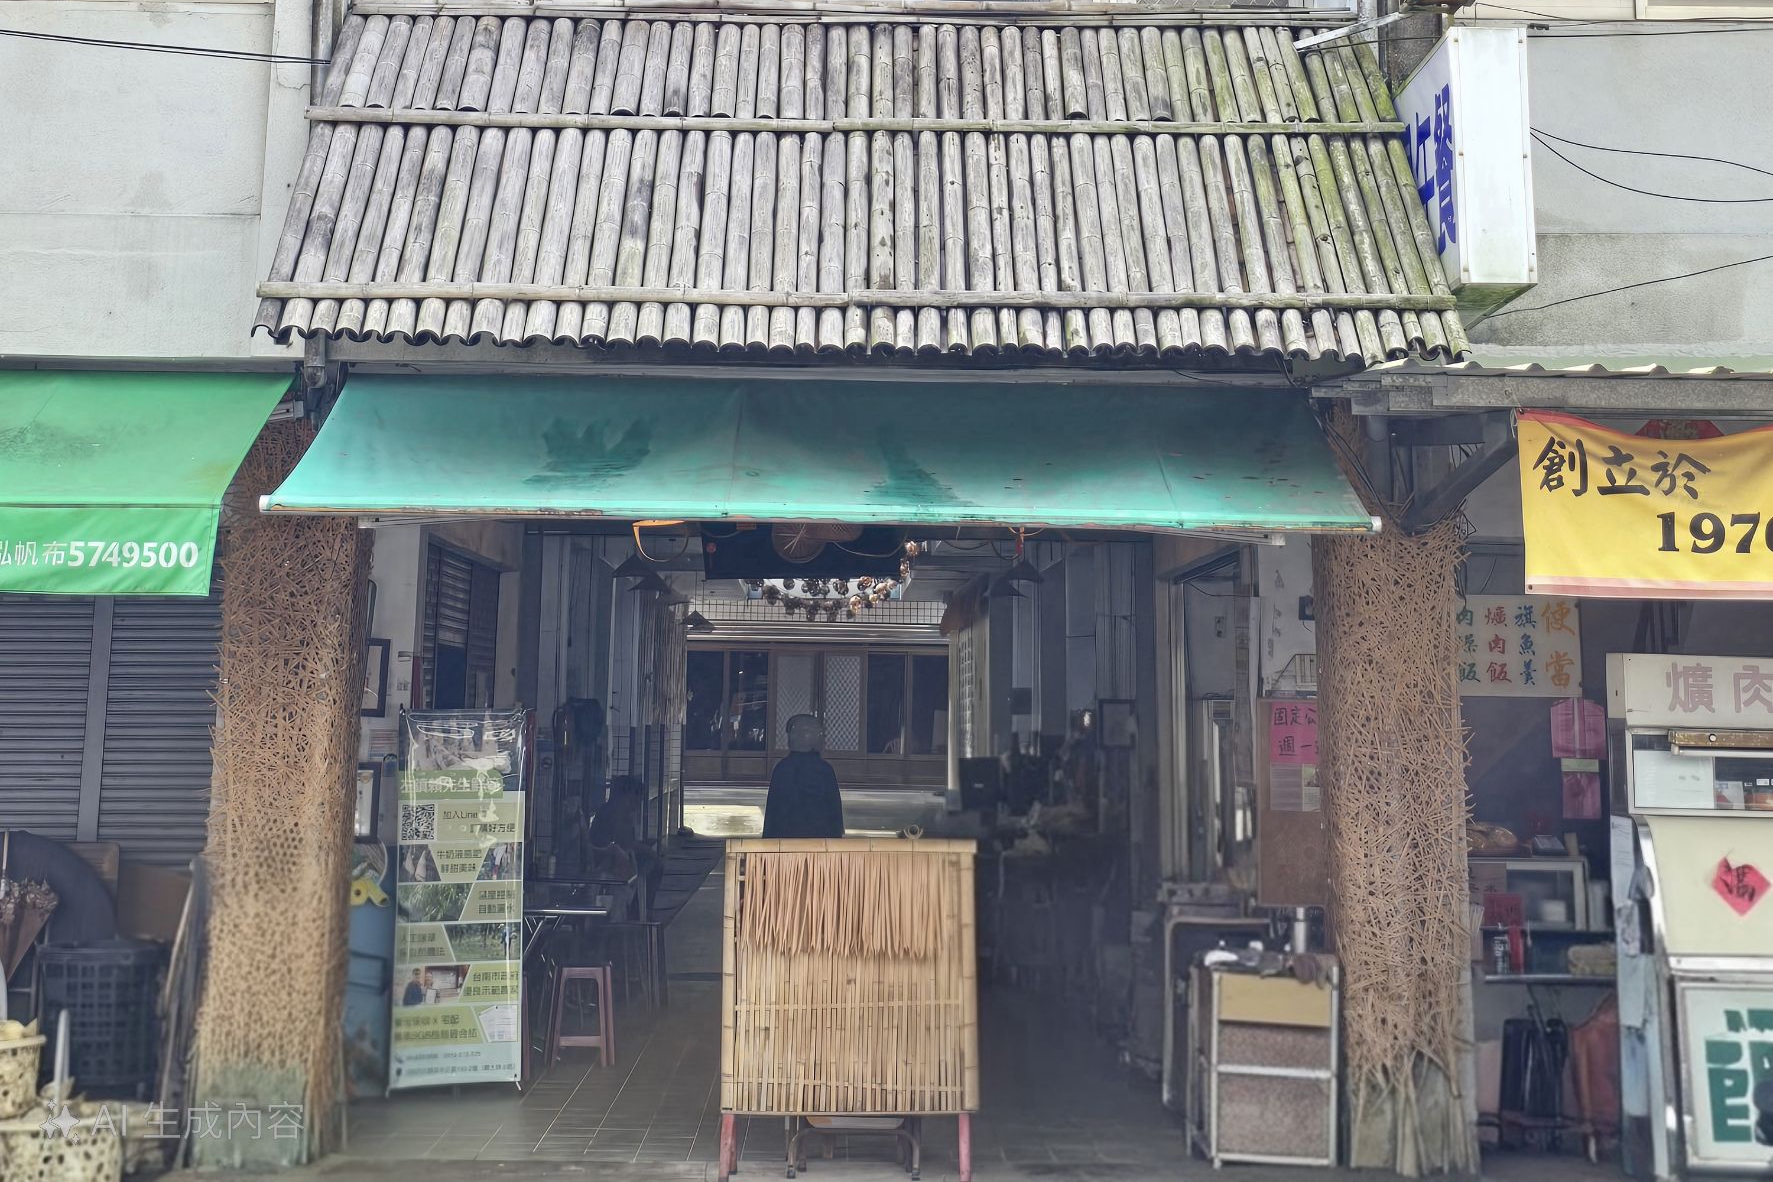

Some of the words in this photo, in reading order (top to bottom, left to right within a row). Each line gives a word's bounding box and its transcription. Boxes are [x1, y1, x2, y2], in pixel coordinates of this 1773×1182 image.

[1404, 83, 1457, 256] 午餐
[1533, 436, 1711, 499] 創立於
[1657, 511, 1773, 554] 197
[1515, 605, 1537, 686] 旗魚羹
[1541, 601, 1576, 688] 便當
[1666, 662, 1773, 714] 爌肉
[1278, 735, 1319, 756] 週一
